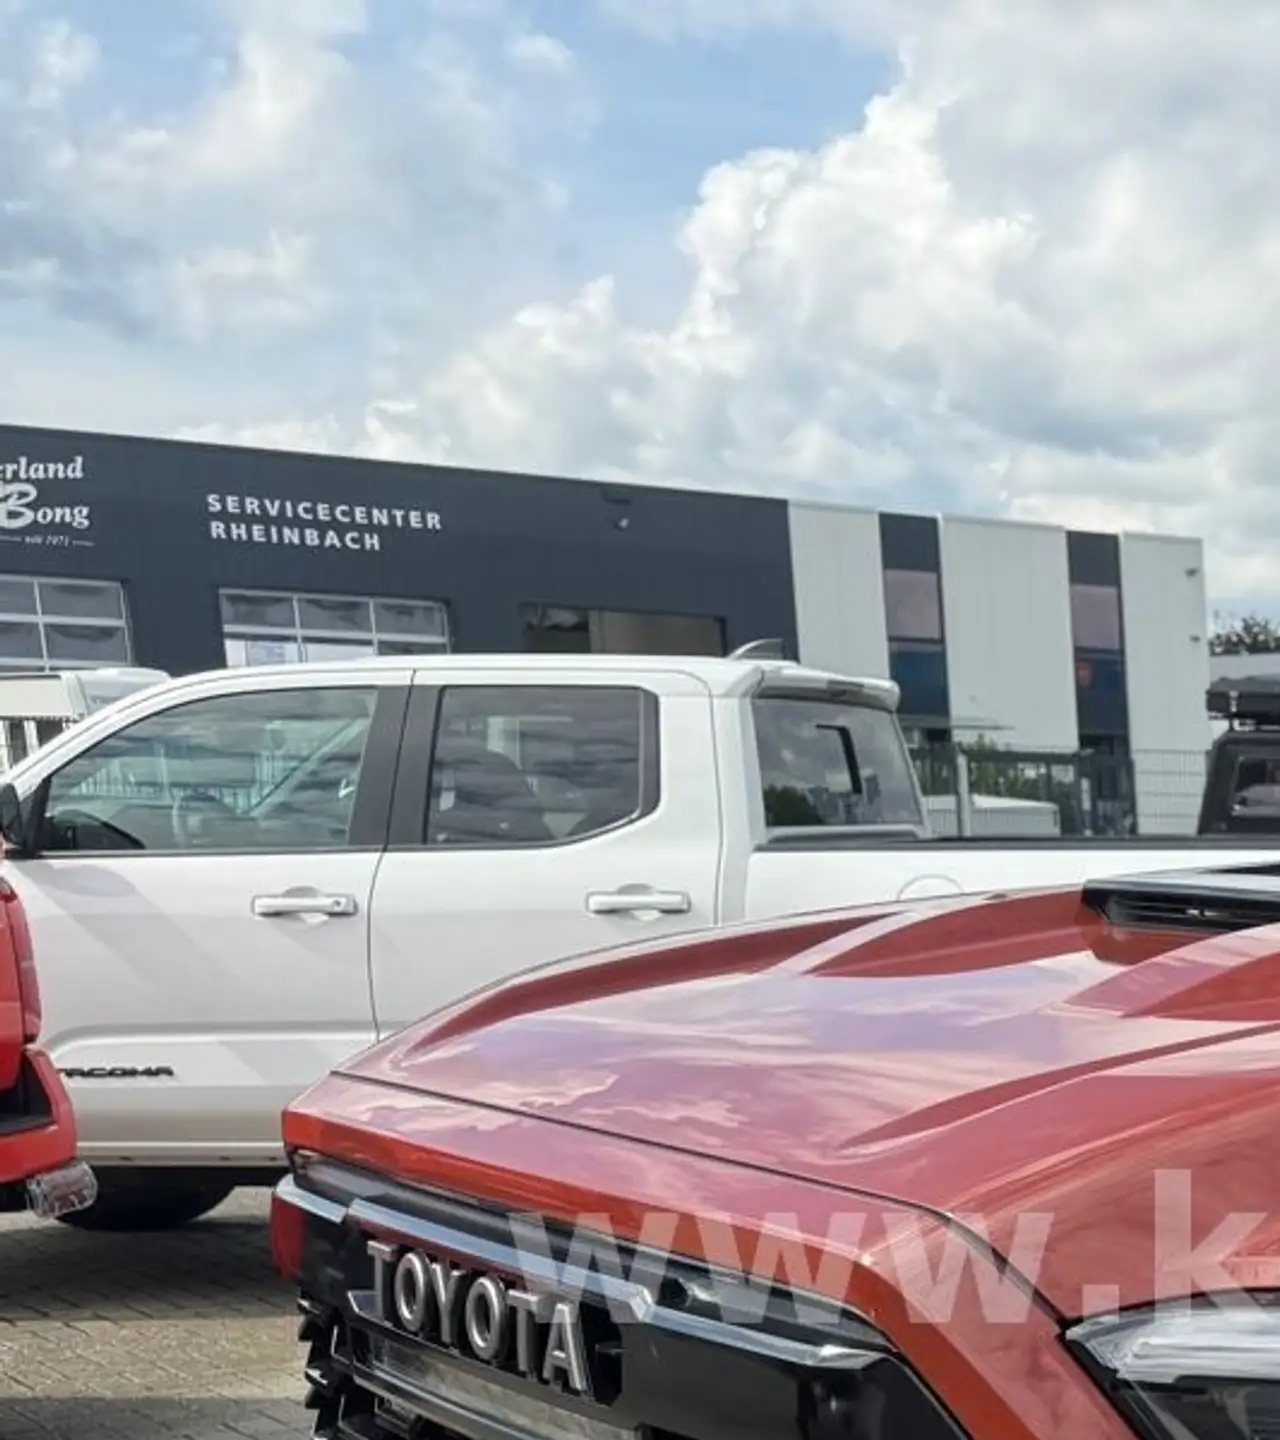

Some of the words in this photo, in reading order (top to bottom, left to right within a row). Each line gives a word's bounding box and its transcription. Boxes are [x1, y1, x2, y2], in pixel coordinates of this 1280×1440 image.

[206, 493, 442, 530] SERVICECENTER
[210, 520, 381, 551] RHEINBACH
[367, 1240, 590, 1391] TOYOTA
